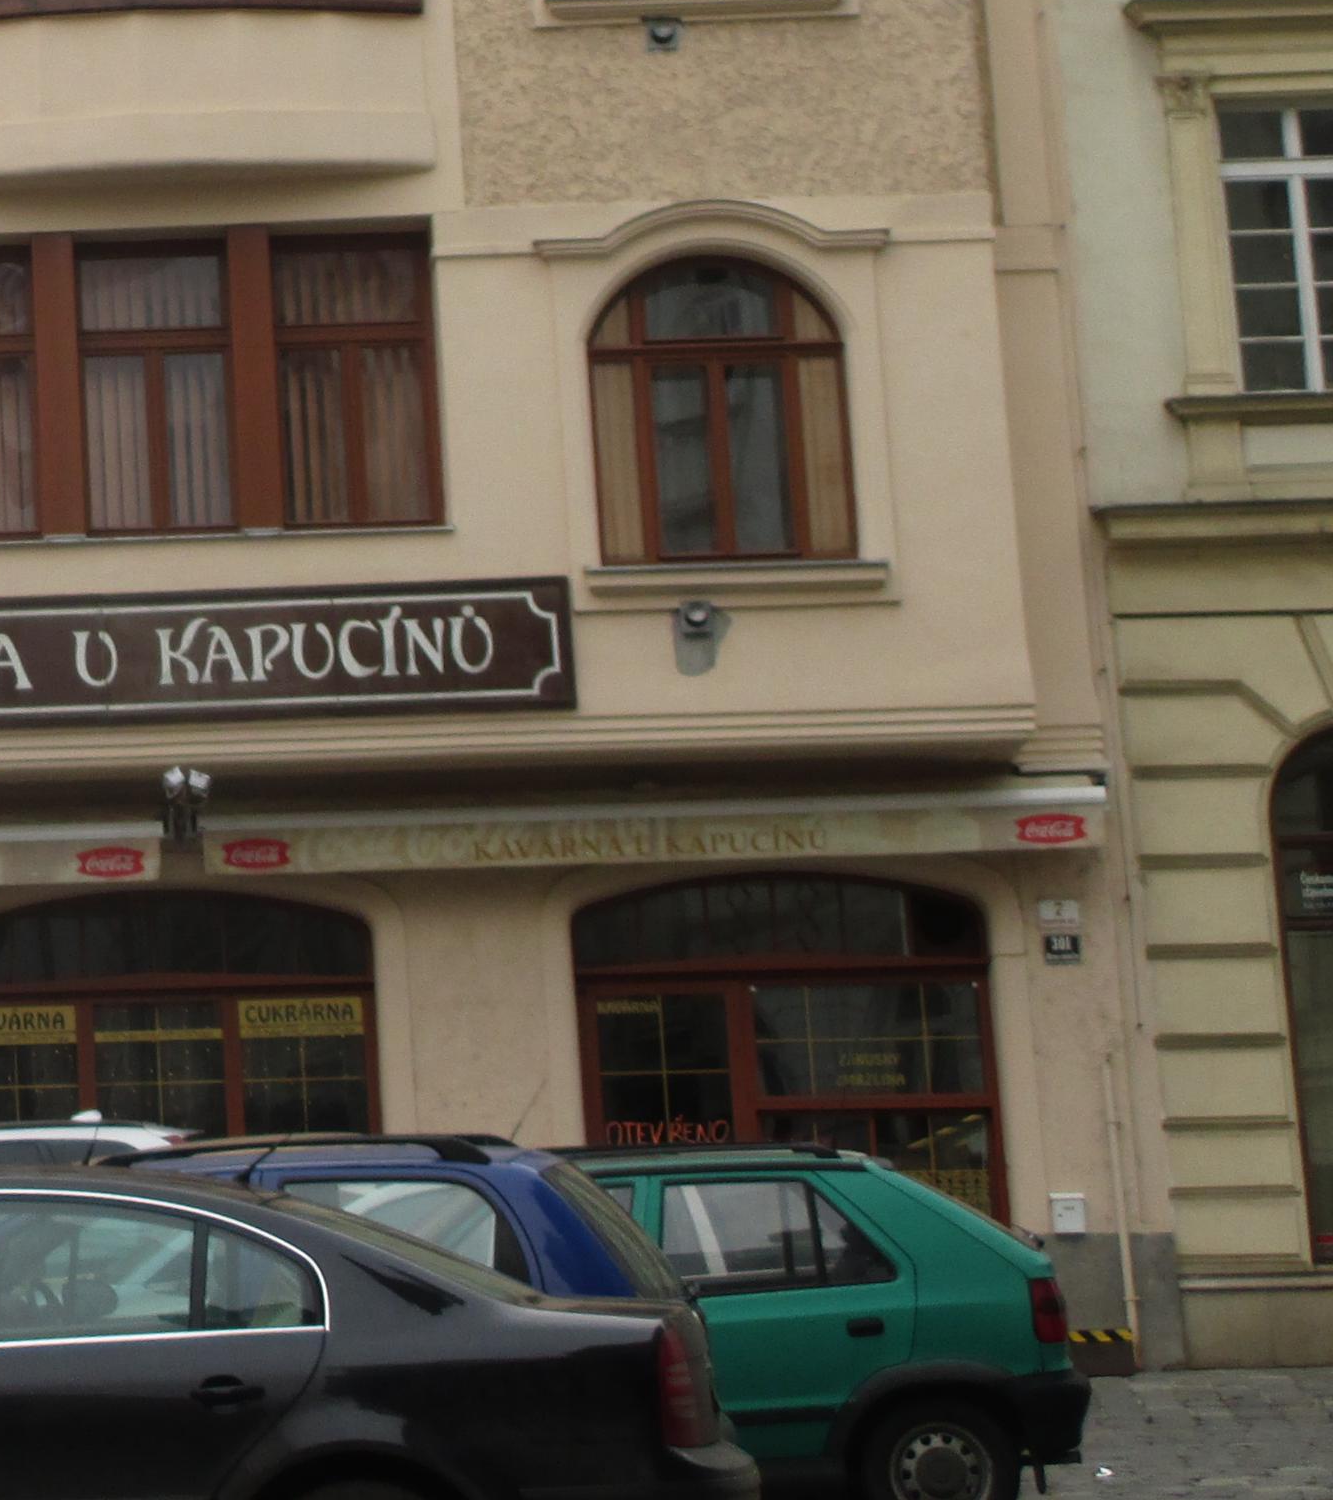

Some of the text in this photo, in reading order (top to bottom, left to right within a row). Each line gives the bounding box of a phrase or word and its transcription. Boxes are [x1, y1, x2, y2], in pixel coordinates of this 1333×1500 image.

[72, 629, 119, 687] U
[156, 605, 494, 686] KAPUCÍNŮ
[245, 998, 355, 1024] CUKRÁRNA
